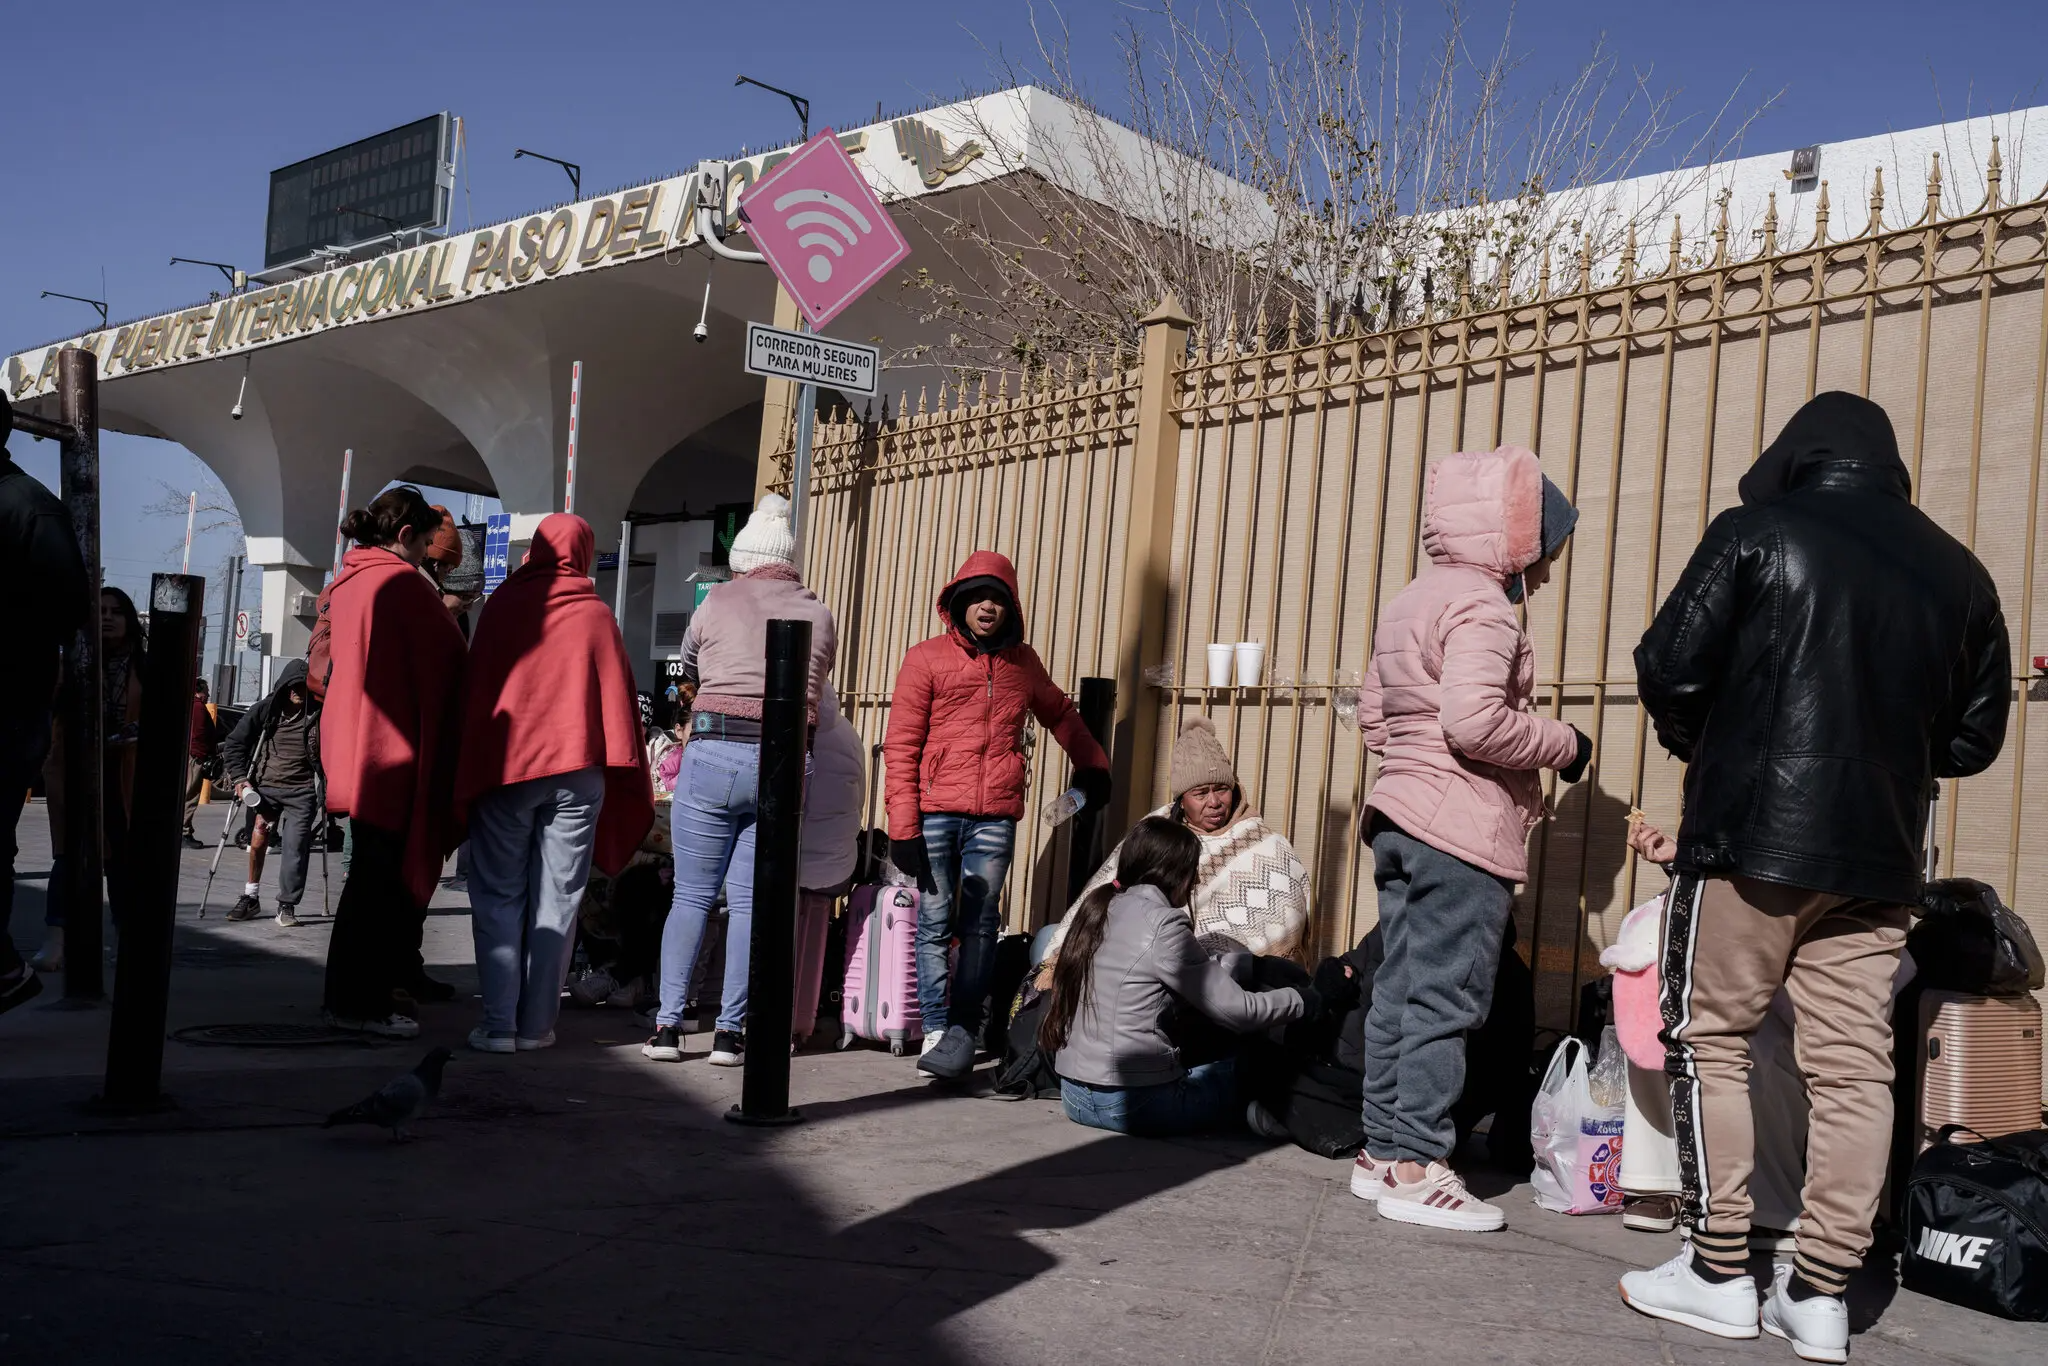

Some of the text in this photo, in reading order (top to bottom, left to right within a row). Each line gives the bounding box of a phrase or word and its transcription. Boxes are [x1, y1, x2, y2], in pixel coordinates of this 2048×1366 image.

[105, 304, 214, 375] PUENTE
[208, 243, 456, 353] INTERNACIONAL
[462, 208, 578, 294] PASO
[576, 186, 668, 266] DEL
[756, 334, 870, 369] CORREDOR SEGURO
[768, 353, 857, 382] PARA MUJERES
[664, 662, 684, 676] 103
[1916, 1226, 1994, 1269] NIKE
